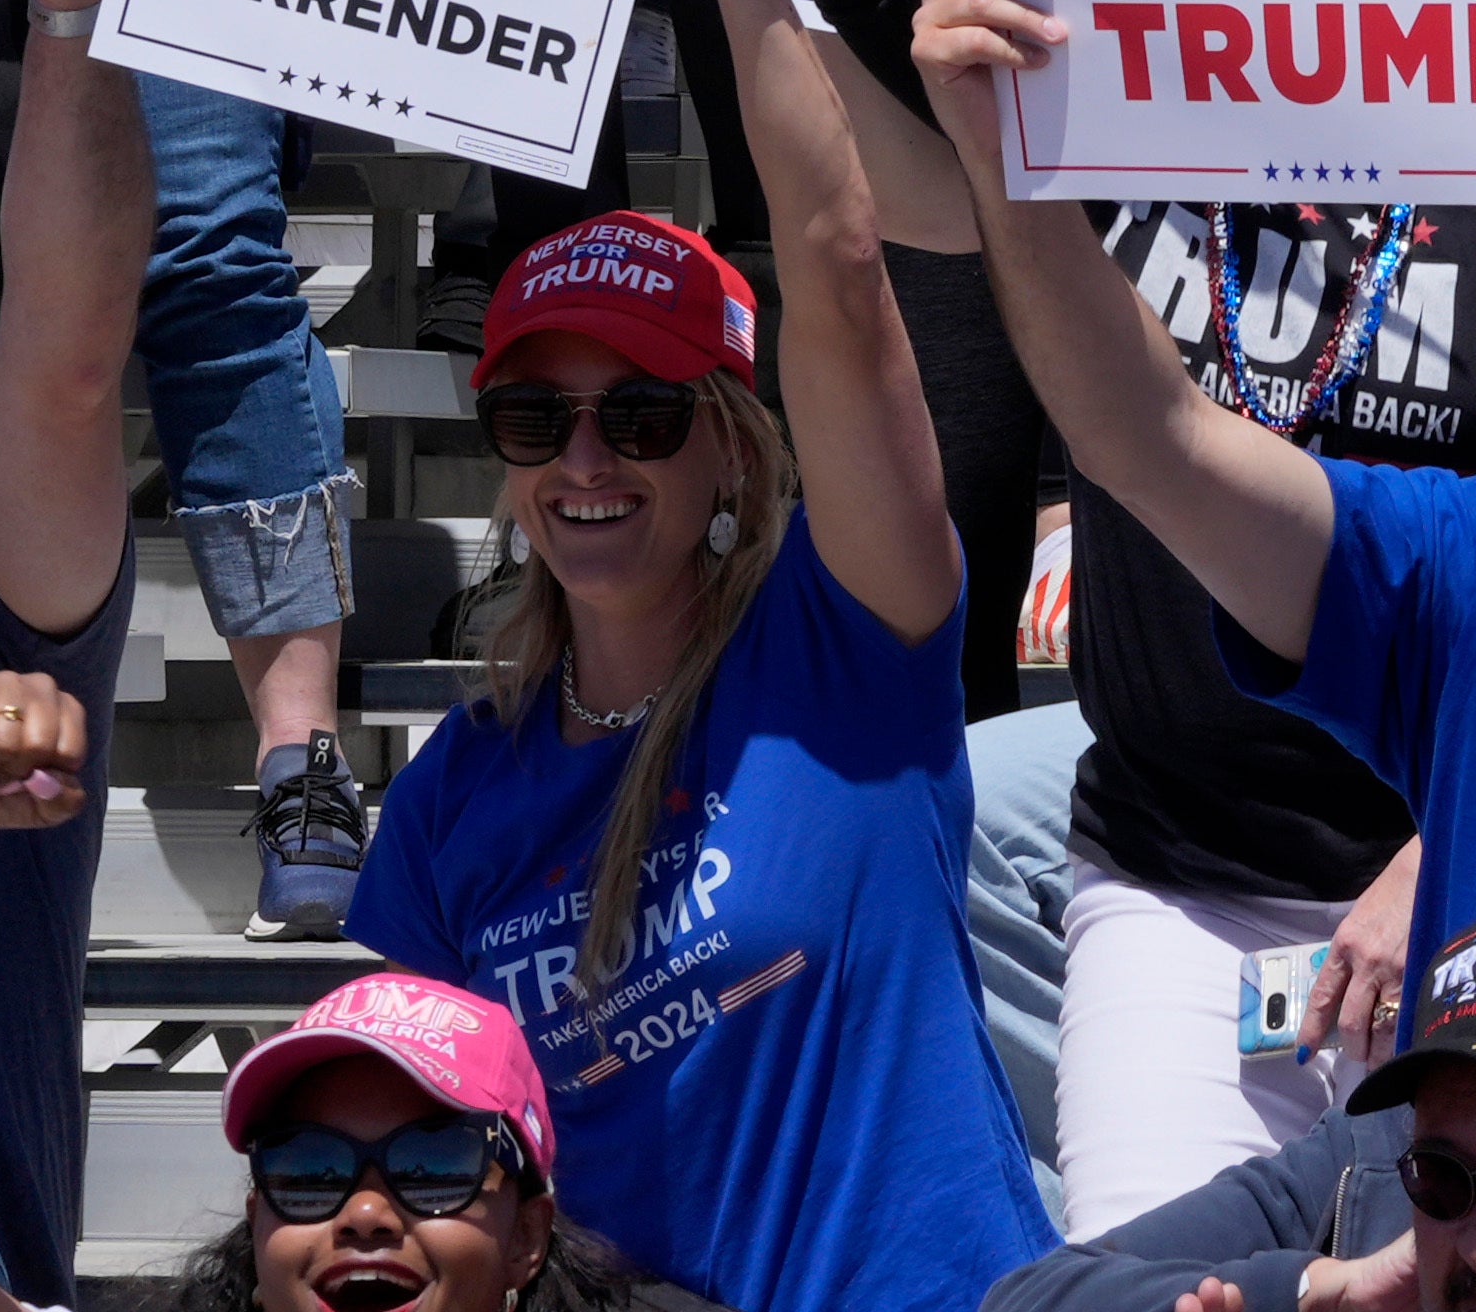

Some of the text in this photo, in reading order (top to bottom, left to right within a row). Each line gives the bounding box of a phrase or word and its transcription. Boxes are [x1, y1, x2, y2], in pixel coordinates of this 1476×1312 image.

[524, 224, 692, 268] NEW JERSEY
[571, 242, 628, 260] FOR
[521, 257, 675, 301] TRUMP
[1353, 394, 1463, 445] BACK!
[481, 907, 549, 952] NEW
[539, 929, 732, 1053] TAKE AMERICA BACK!
[613, 986, 717, 1065] 2024
